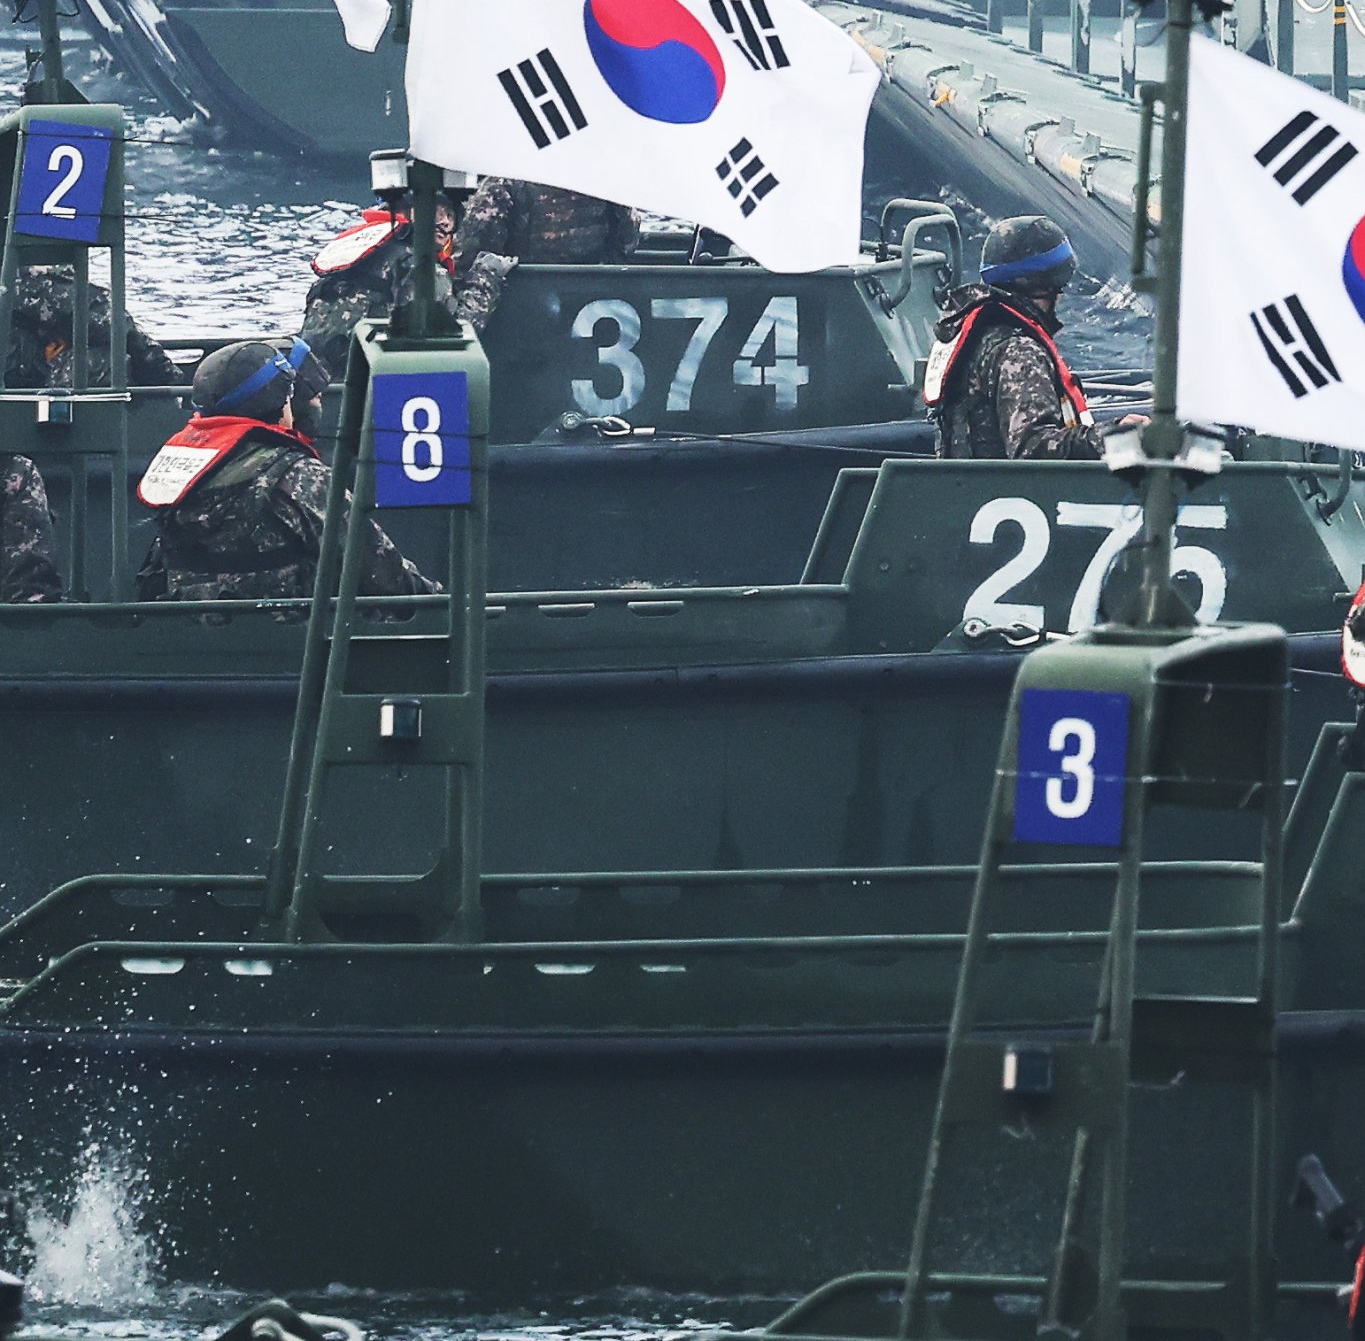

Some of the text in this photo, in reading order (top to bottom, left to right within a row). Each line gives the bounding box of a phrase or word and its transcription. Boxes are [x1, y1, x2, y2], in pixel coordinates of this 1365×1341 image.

[42, 145, 83, 219] 2
[571, 296, 809, 416] 374
[402, 397, 443, 482] 8
[963, 497, 1228, 633] 275
[1046, 717, 1096, 819] 3
